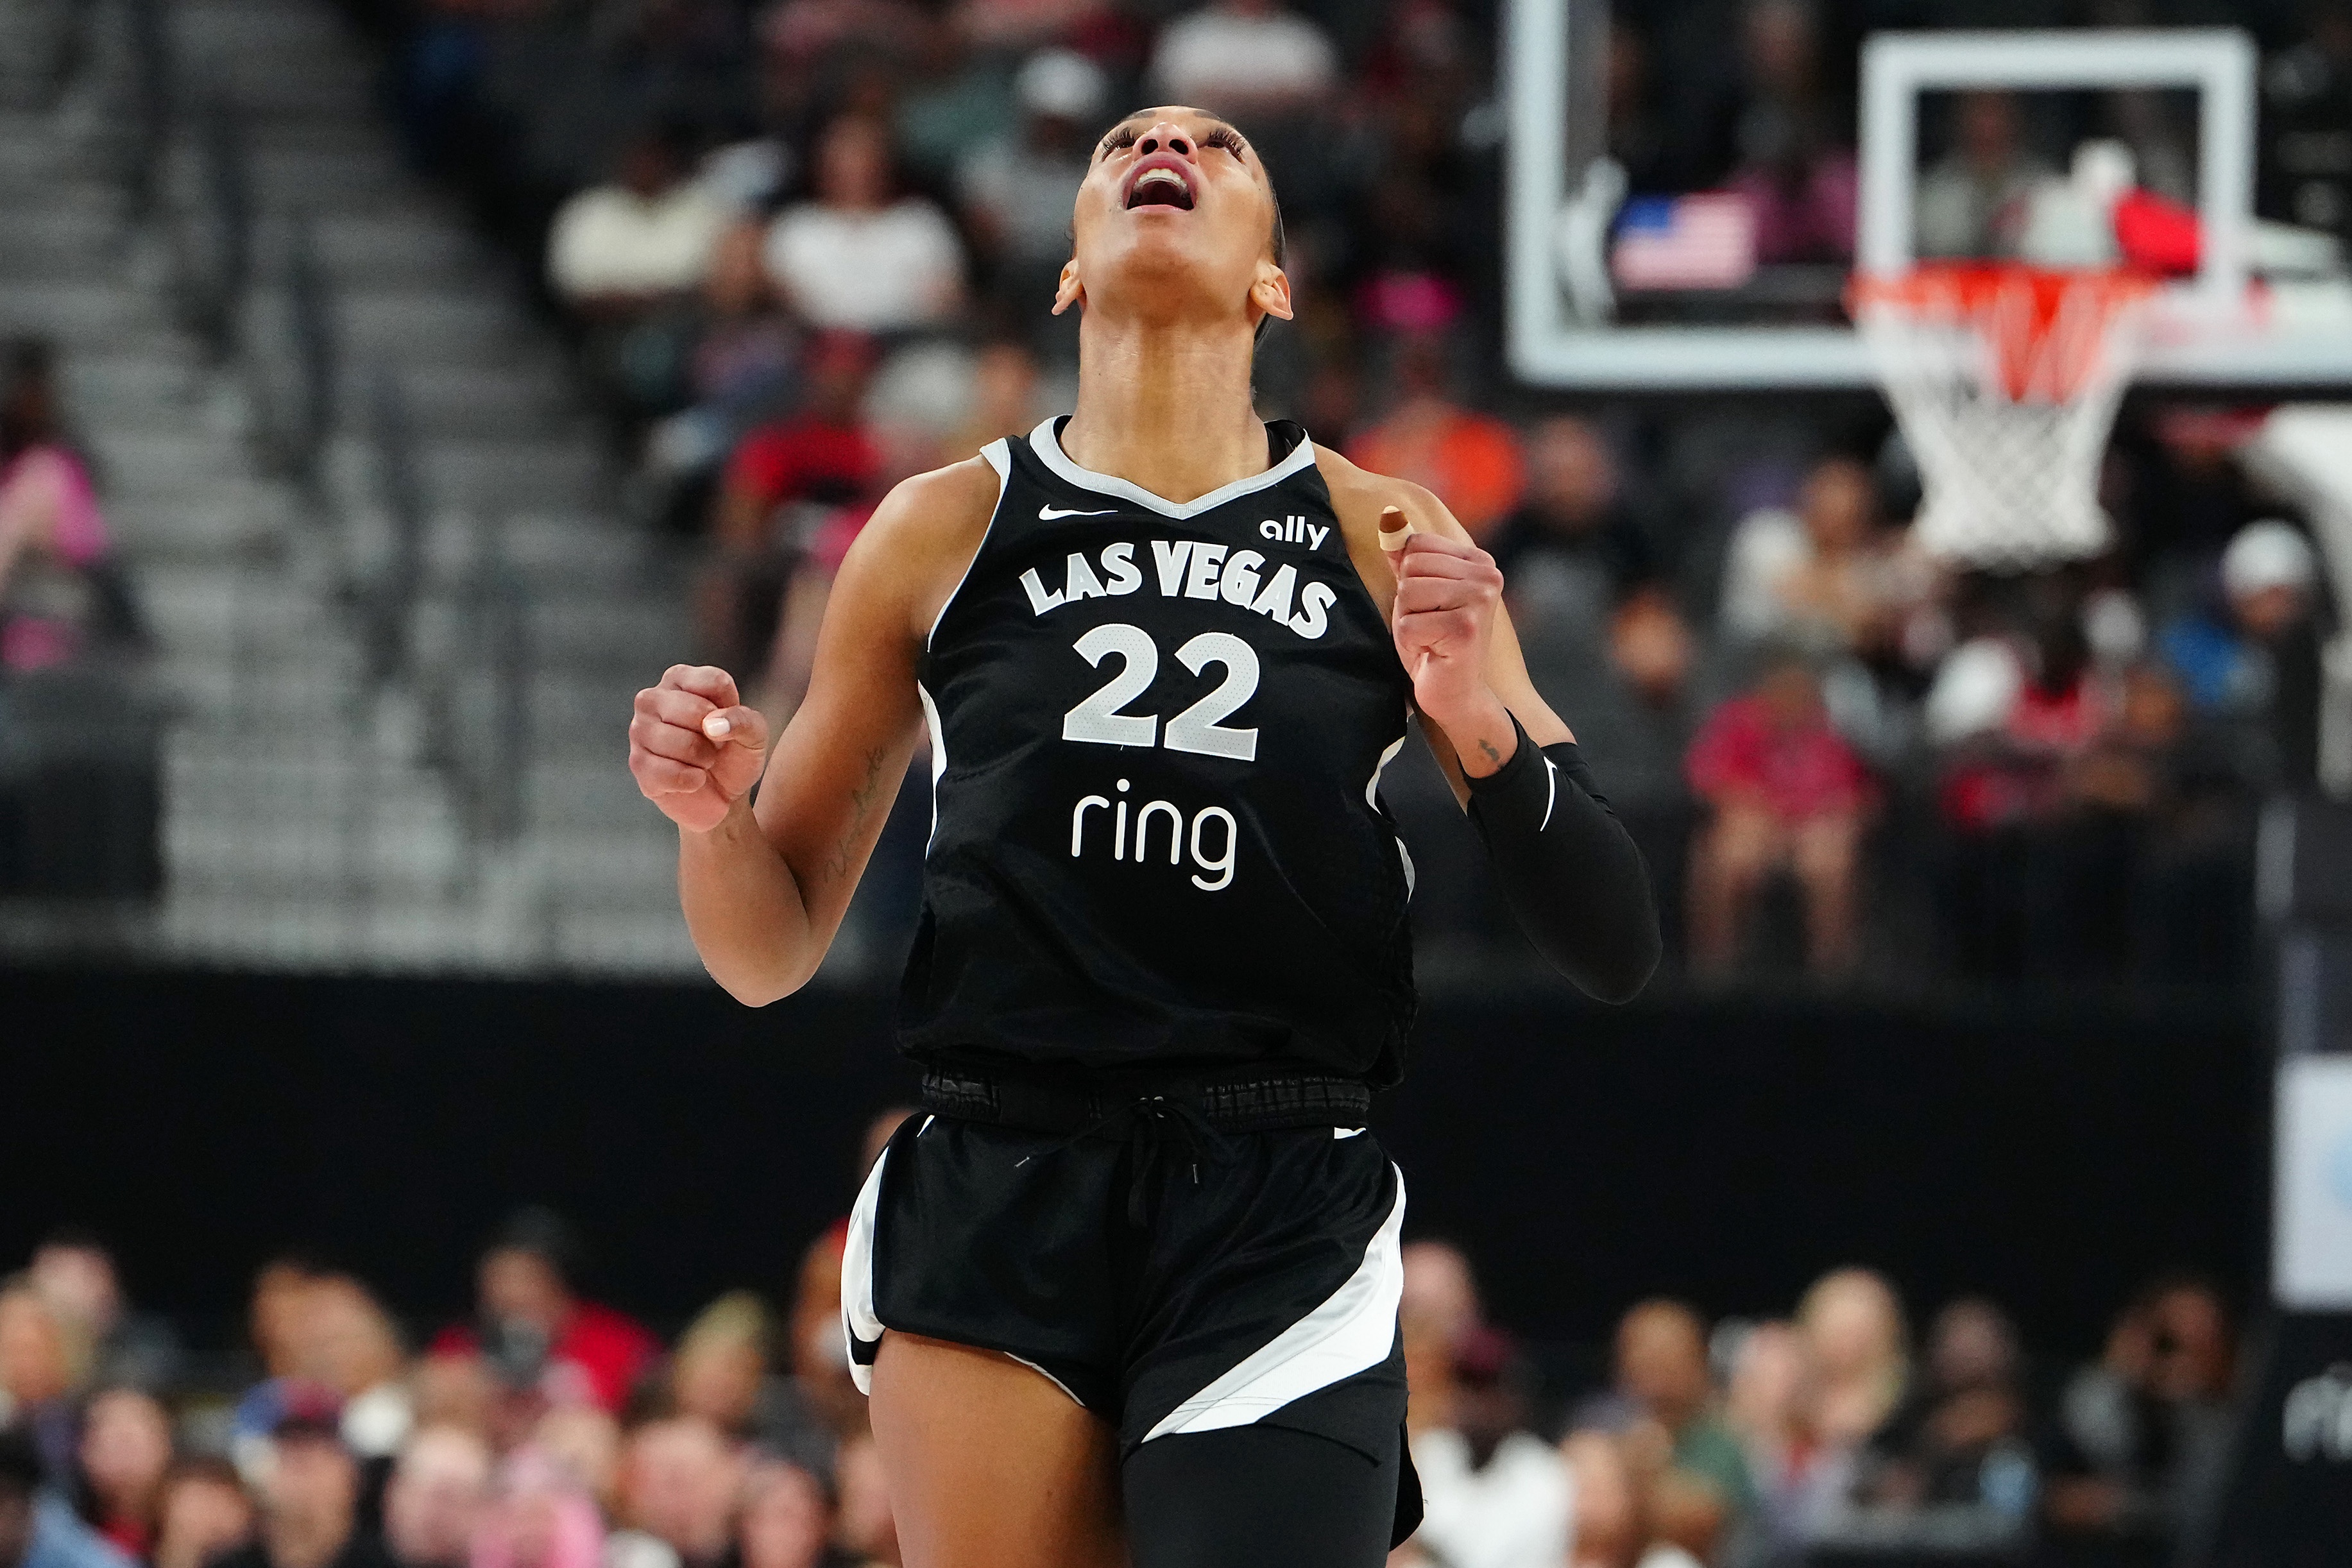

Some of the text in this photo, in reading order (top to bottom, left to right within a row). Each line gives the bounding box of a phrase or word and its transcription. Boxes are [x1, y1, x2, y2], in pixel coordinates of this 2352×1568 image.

[1259, 515, 1331, 551] ally
[1019, 540, 1338, 640] LAS VEGAS
[1062, 623, 1260, 762] 22
[1071, 778, 1237, 891] ring
